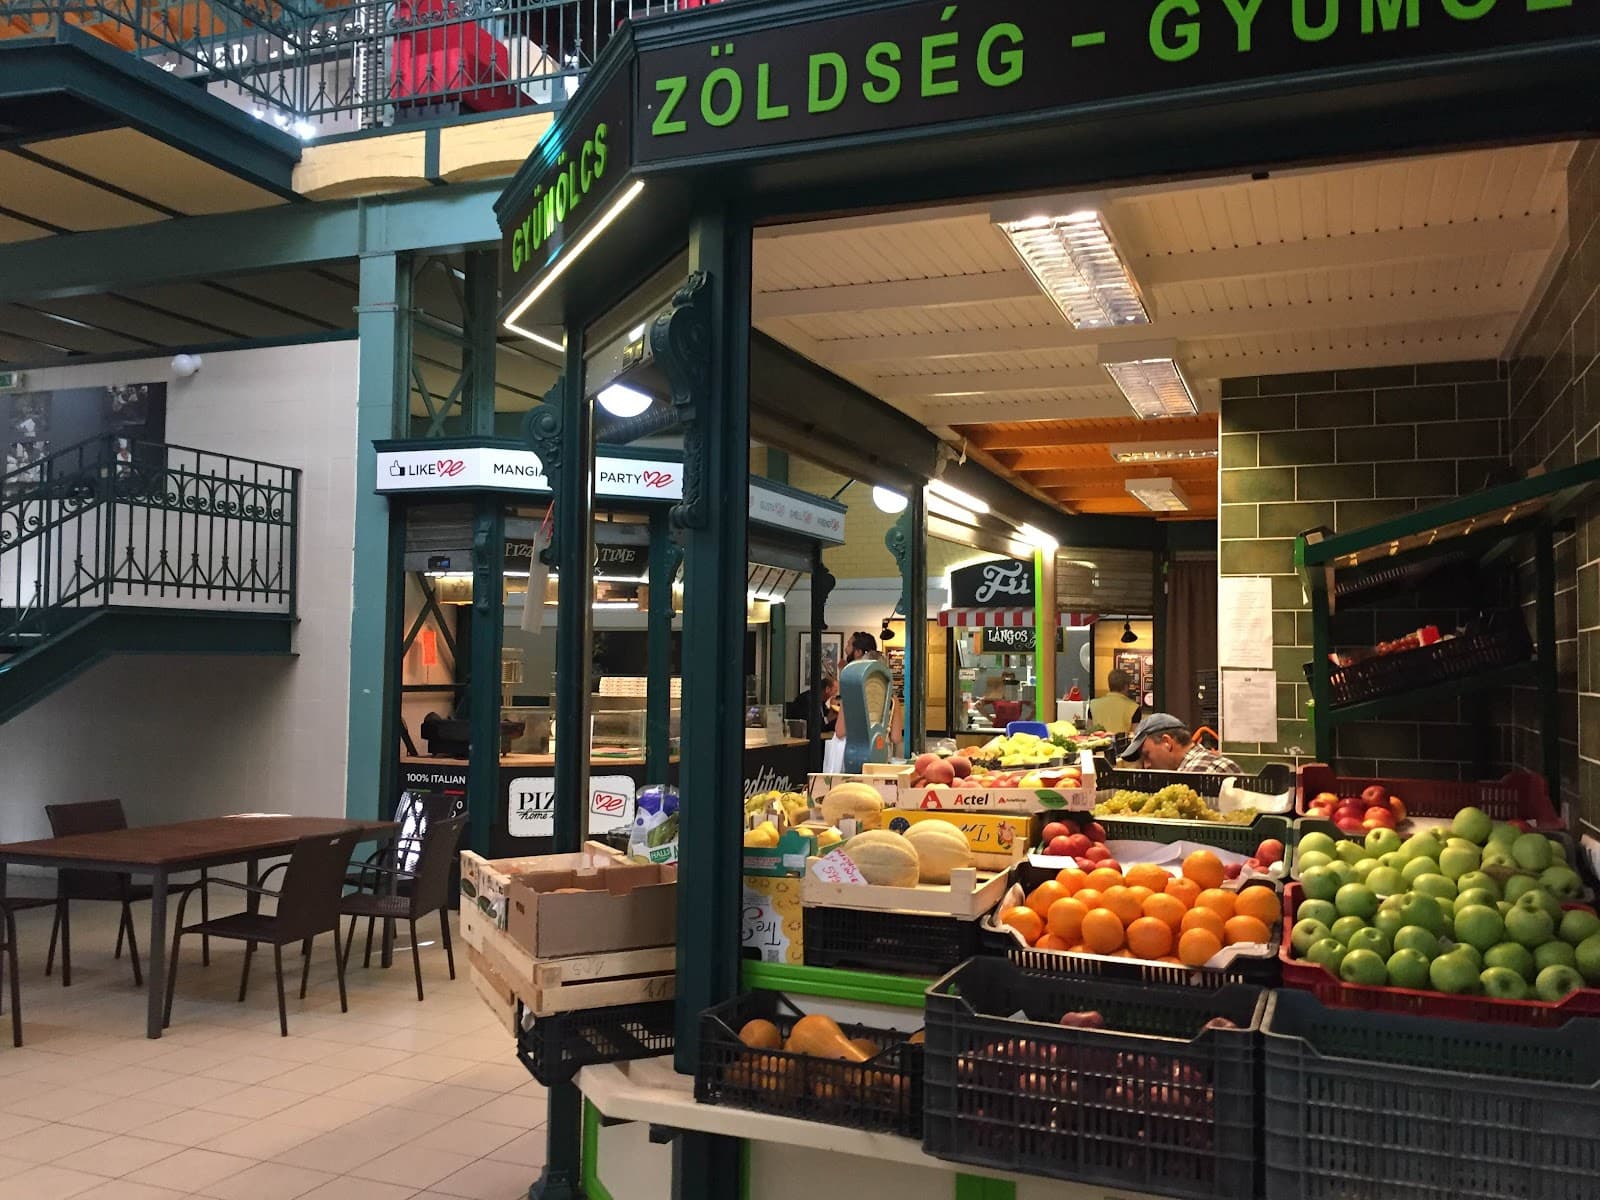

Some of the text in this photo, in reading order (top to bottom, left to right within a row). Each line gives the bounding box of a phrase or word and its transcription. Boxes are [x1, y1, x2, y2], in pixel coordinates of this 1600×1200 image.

[651, 5, 1025, 136] ZÖLDSÉG
[512, 122, 608, 273] GYÜMÖLCS
[408, 463, 436, 476] LIKE
[493, 463, 545, 477] MANGI
[600, 471, 641, 485] PARTY
[601, 548, 636, 563] TIME
[406, 773, 466, 785] 100% ITALIAN
[954, 793, 989, 806] Actel
